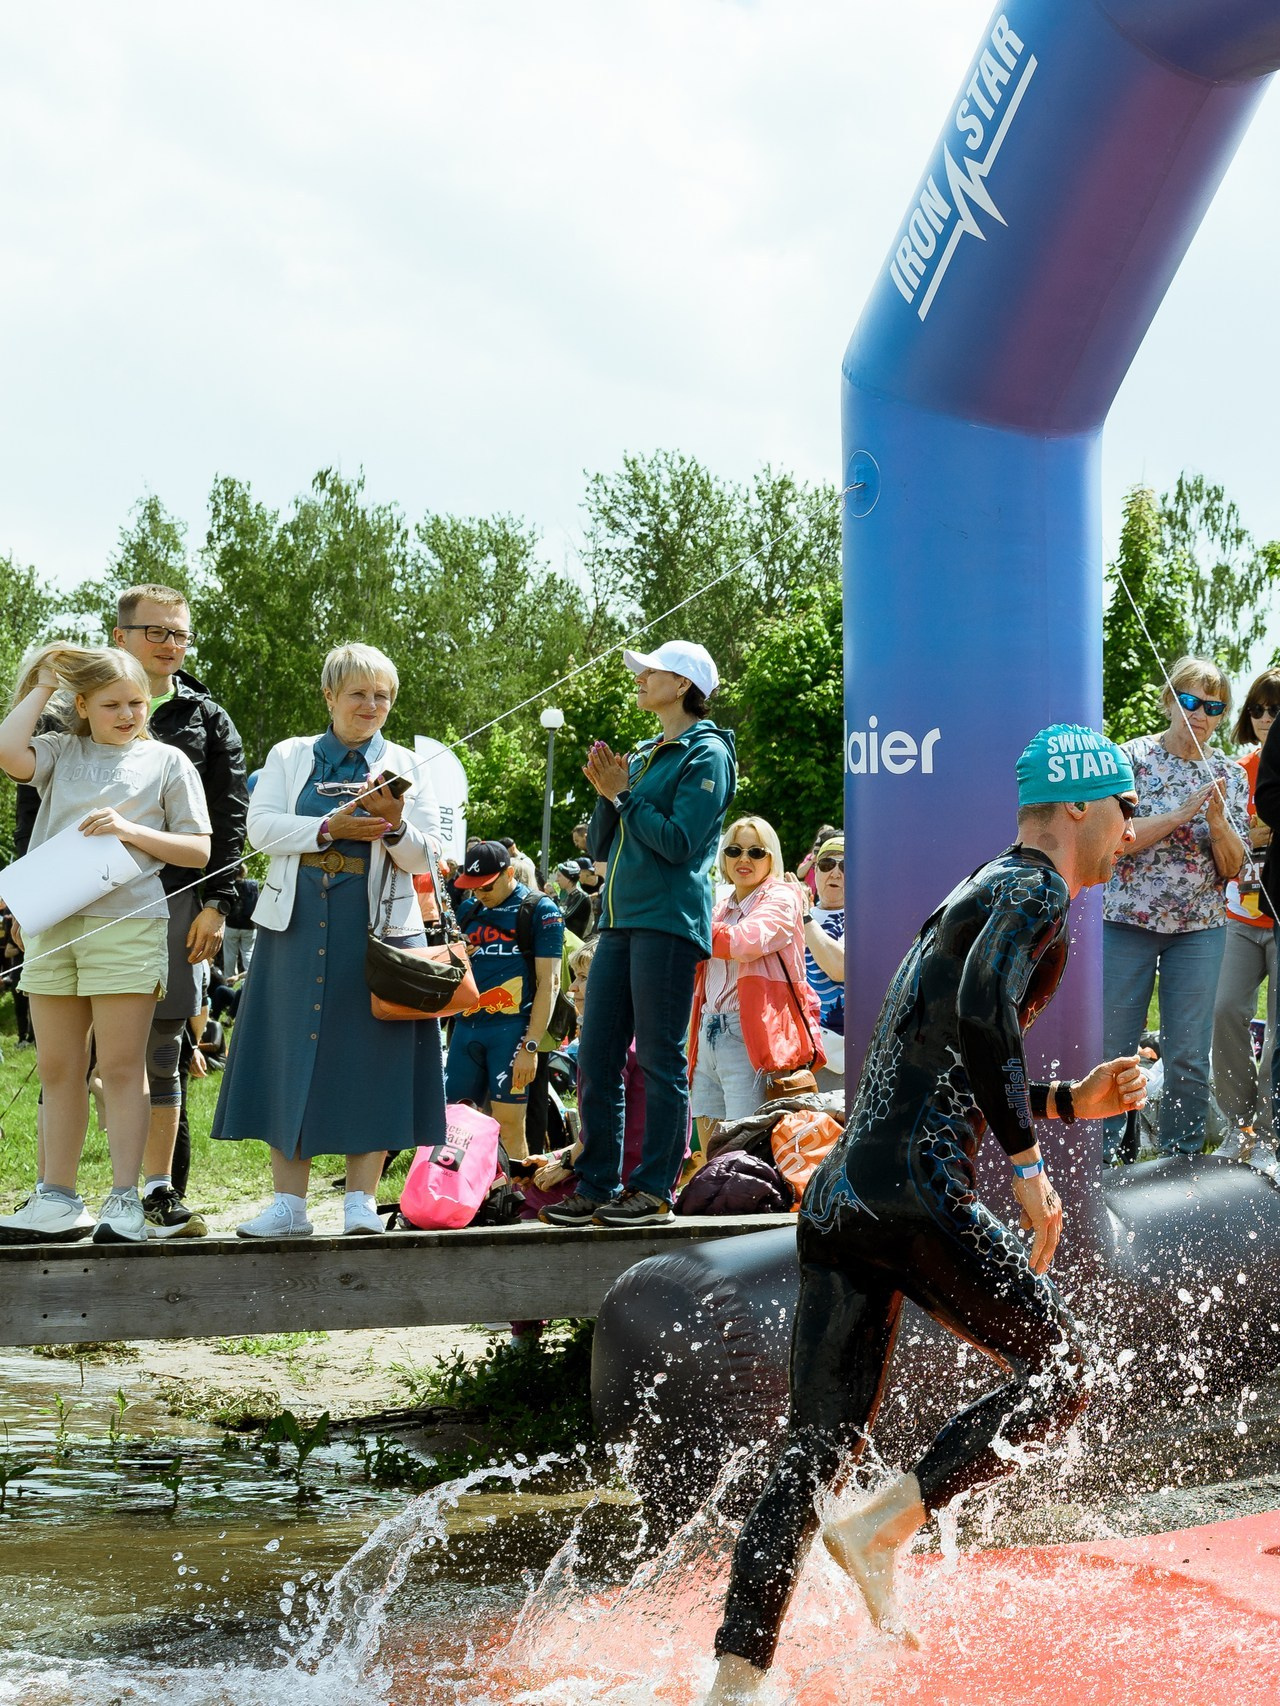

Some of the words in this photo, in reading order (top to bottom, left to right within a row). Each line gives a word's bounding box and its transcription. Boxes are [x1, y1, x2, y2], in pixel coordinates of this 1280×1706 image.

[889, 174, 952, 305] IRON
[955, 14, 1025, 151] STAR
[845, 715, 942, 775] aier
[1047, 734, 1099, 755] SWIM
[1047, 751, 1119, 783] STAR
[1002, 1057, 1031, 1129] sailfish
[437, 1146, 459, 1166] 5
[447, 1133, 472, 1150] ack
